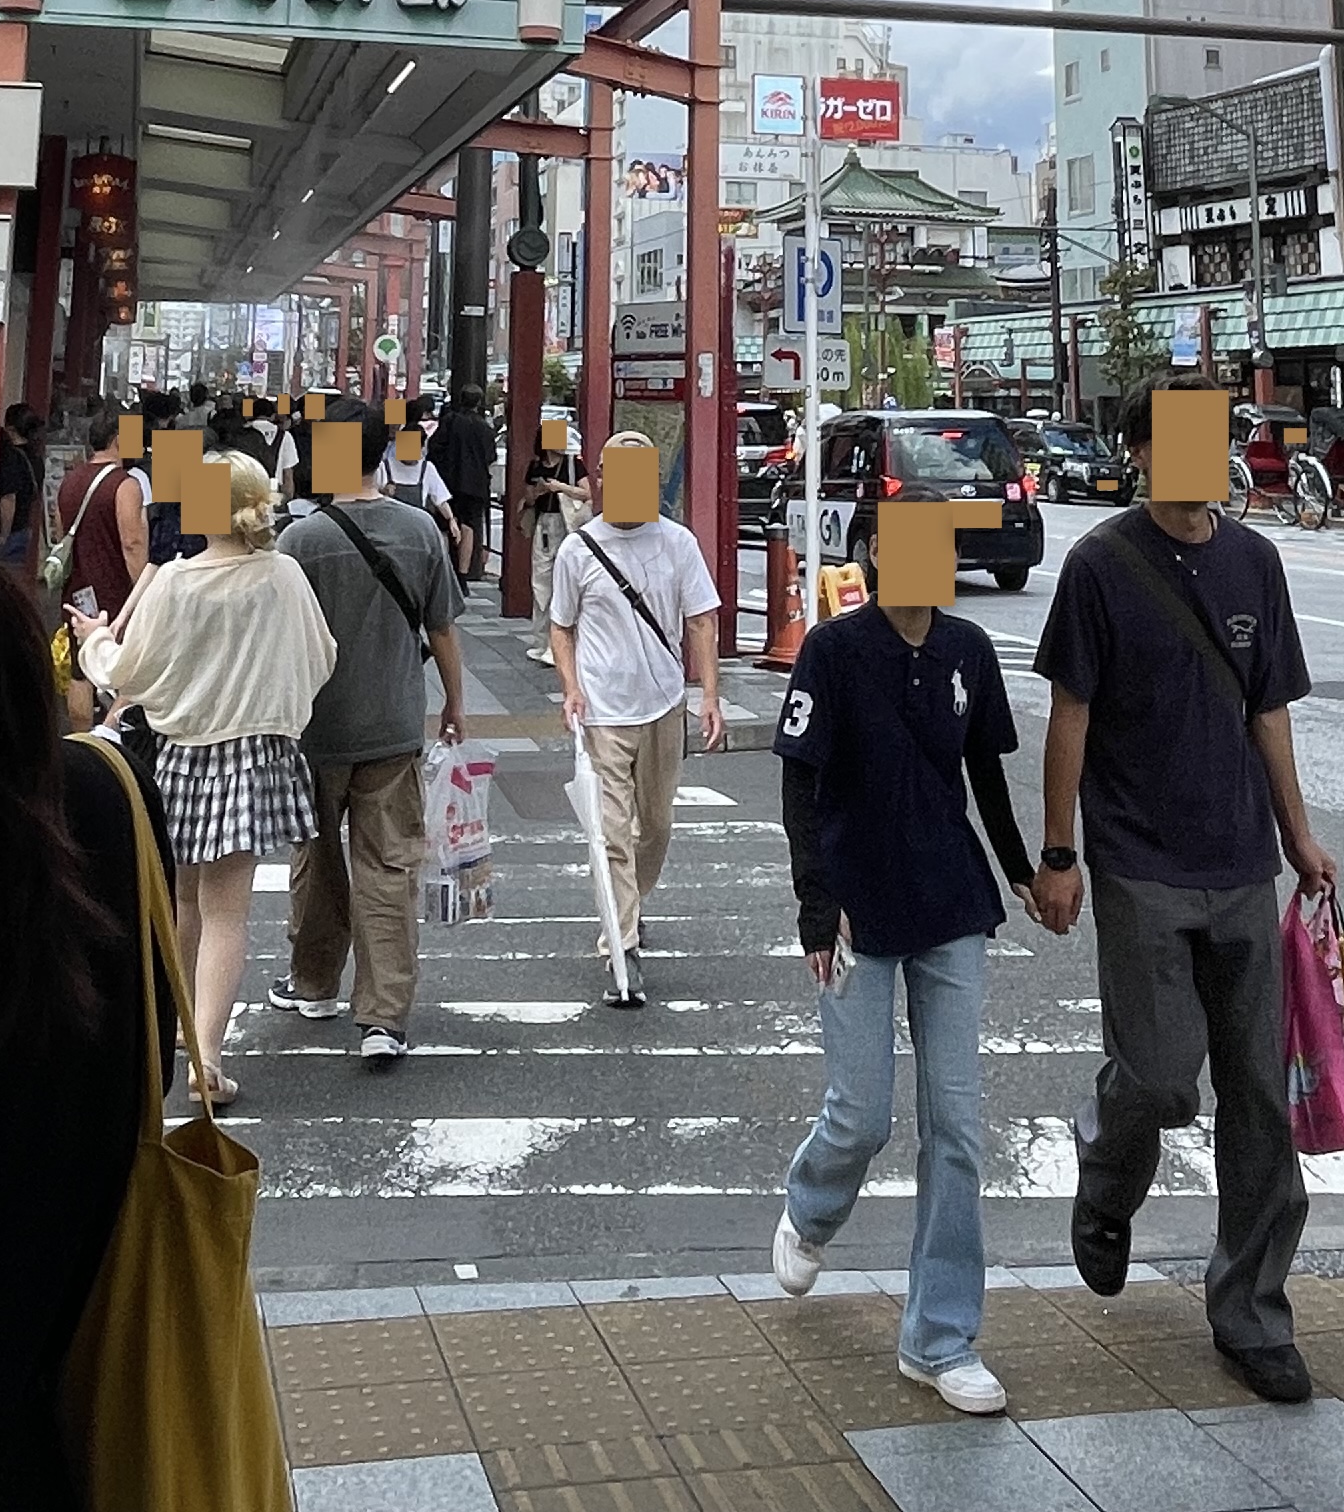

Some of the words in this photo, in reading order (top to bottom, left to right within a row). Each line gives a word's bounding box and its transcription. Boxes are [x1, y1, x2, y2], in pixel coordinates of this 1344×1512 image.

[760, 107, 796, 120] KIRIN
[797, 246, 834, 322] P
[817, 348, 846, 363] の先
[783, 689, 814, 738] 3
